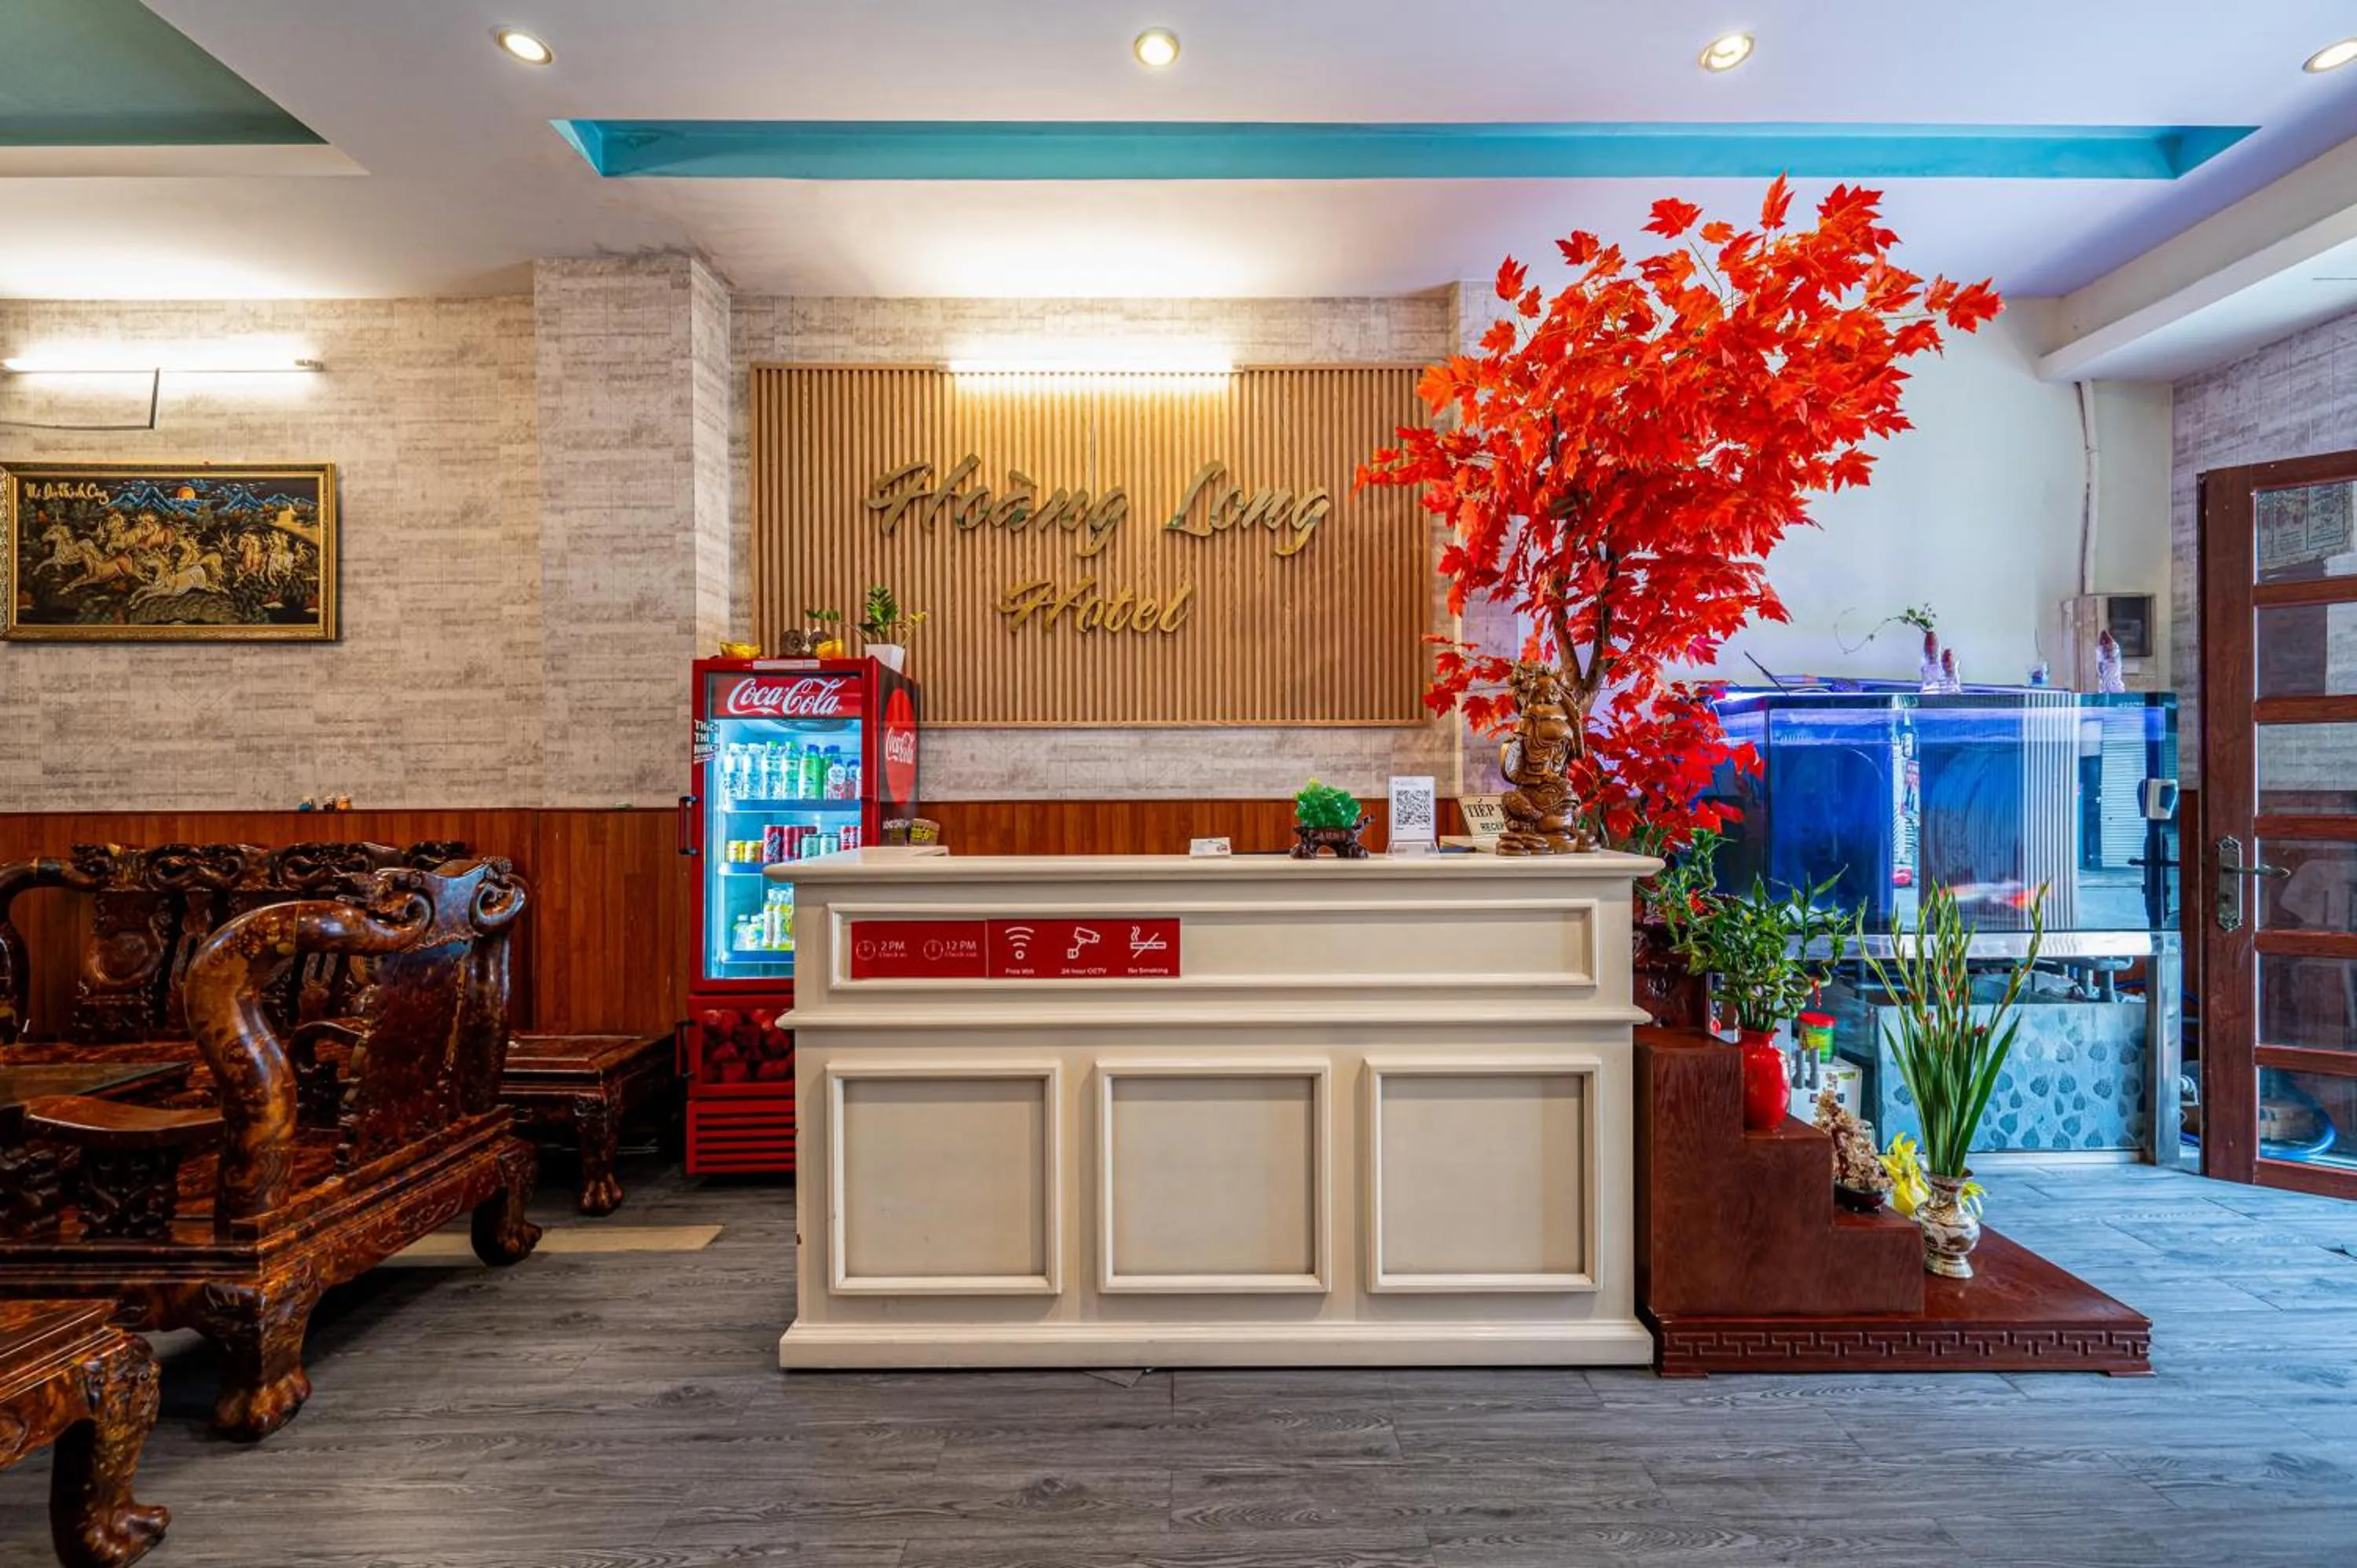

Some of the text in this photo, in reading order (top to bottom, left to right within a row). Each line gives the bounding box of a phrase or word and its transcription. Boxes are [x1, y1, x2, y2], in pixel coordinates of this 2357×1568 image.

[865, 453, 1329, 558] Hoàng Long
[999, 577, 1192, 633] Hotel
[881, 941, 904, 951] 2 PM
[946, 940, 977, 950] 12 PM
